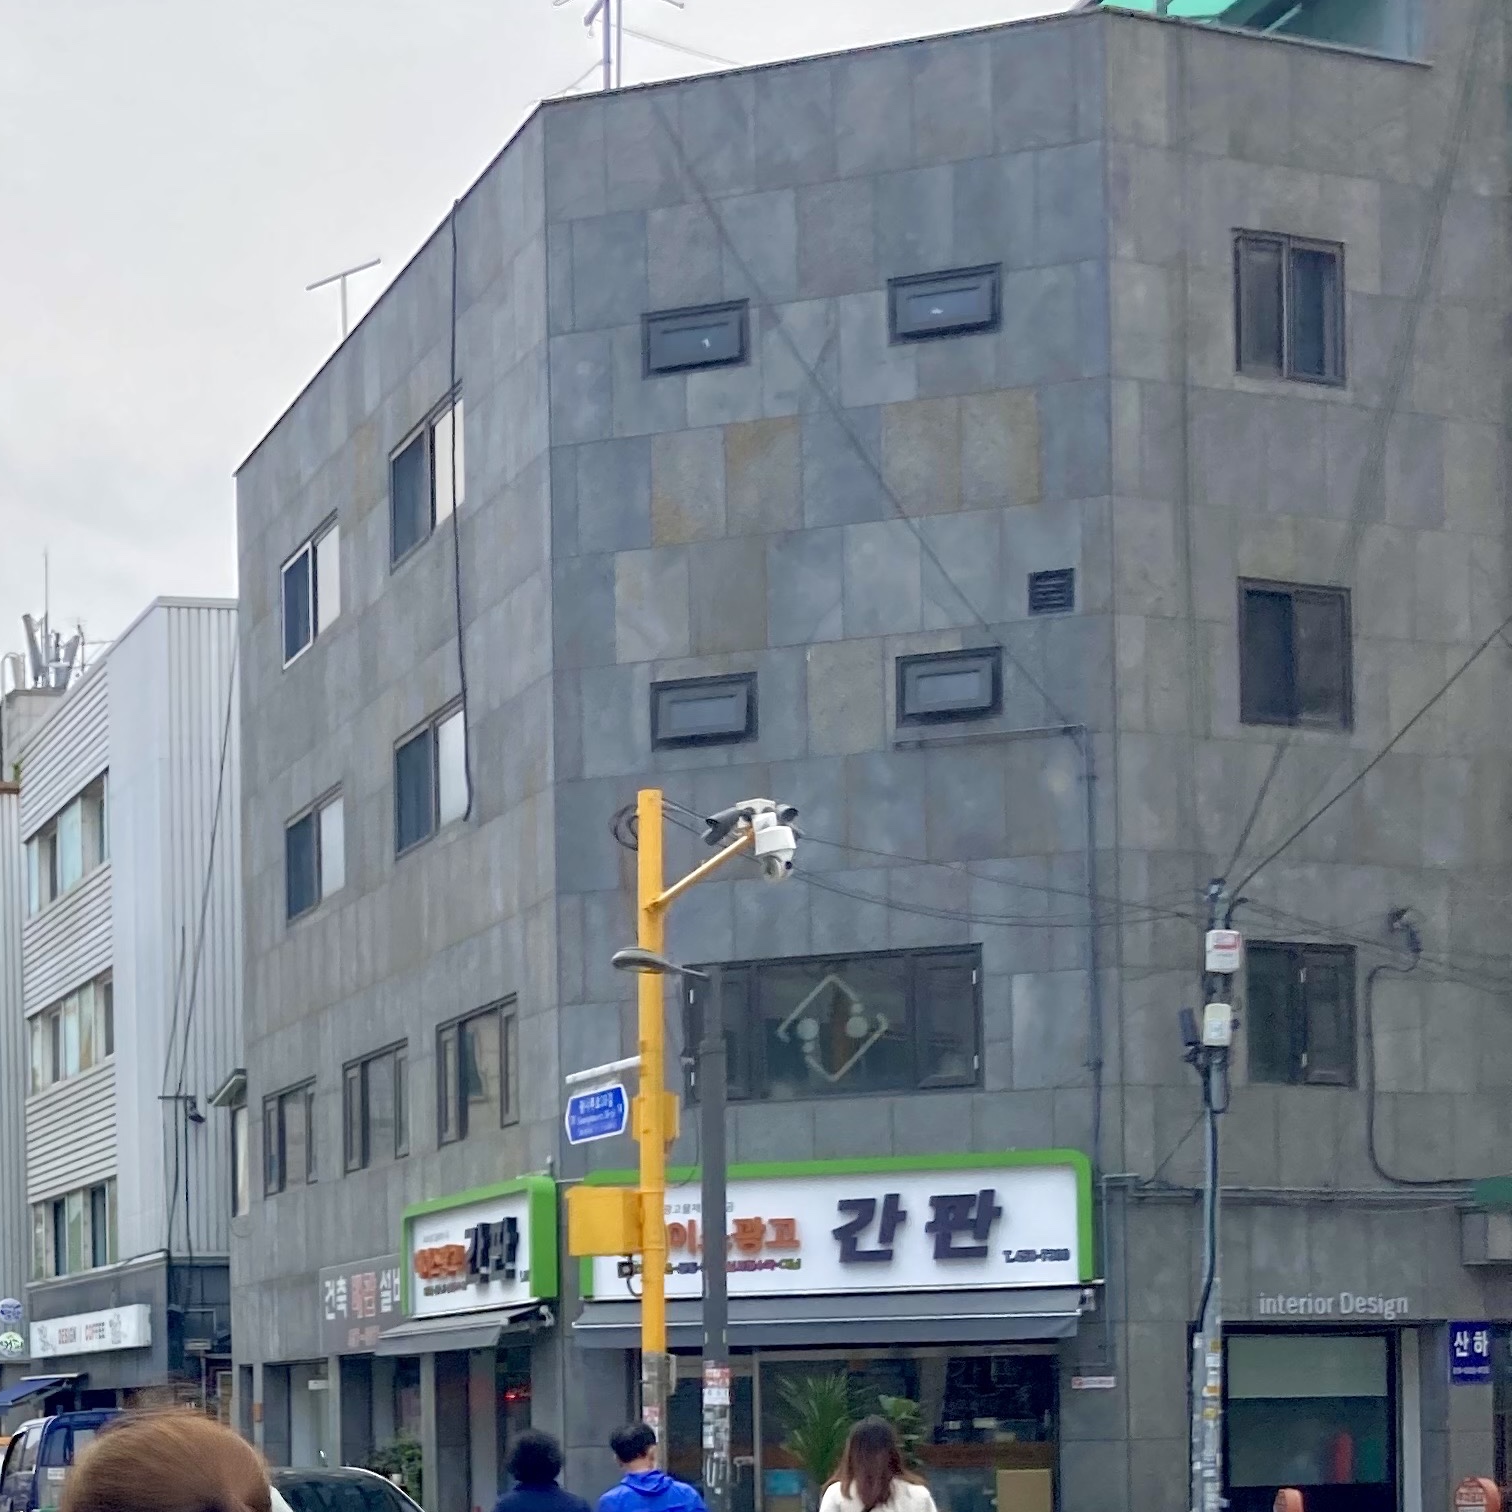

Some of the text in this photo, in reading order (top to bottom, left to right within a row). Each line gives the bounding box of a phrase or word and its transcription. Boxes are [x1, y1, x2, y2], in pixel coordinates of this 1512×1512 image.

[832, 1188, 1004, 1264] 간판
[1258, 1291, 1409, 1321] interior Design
